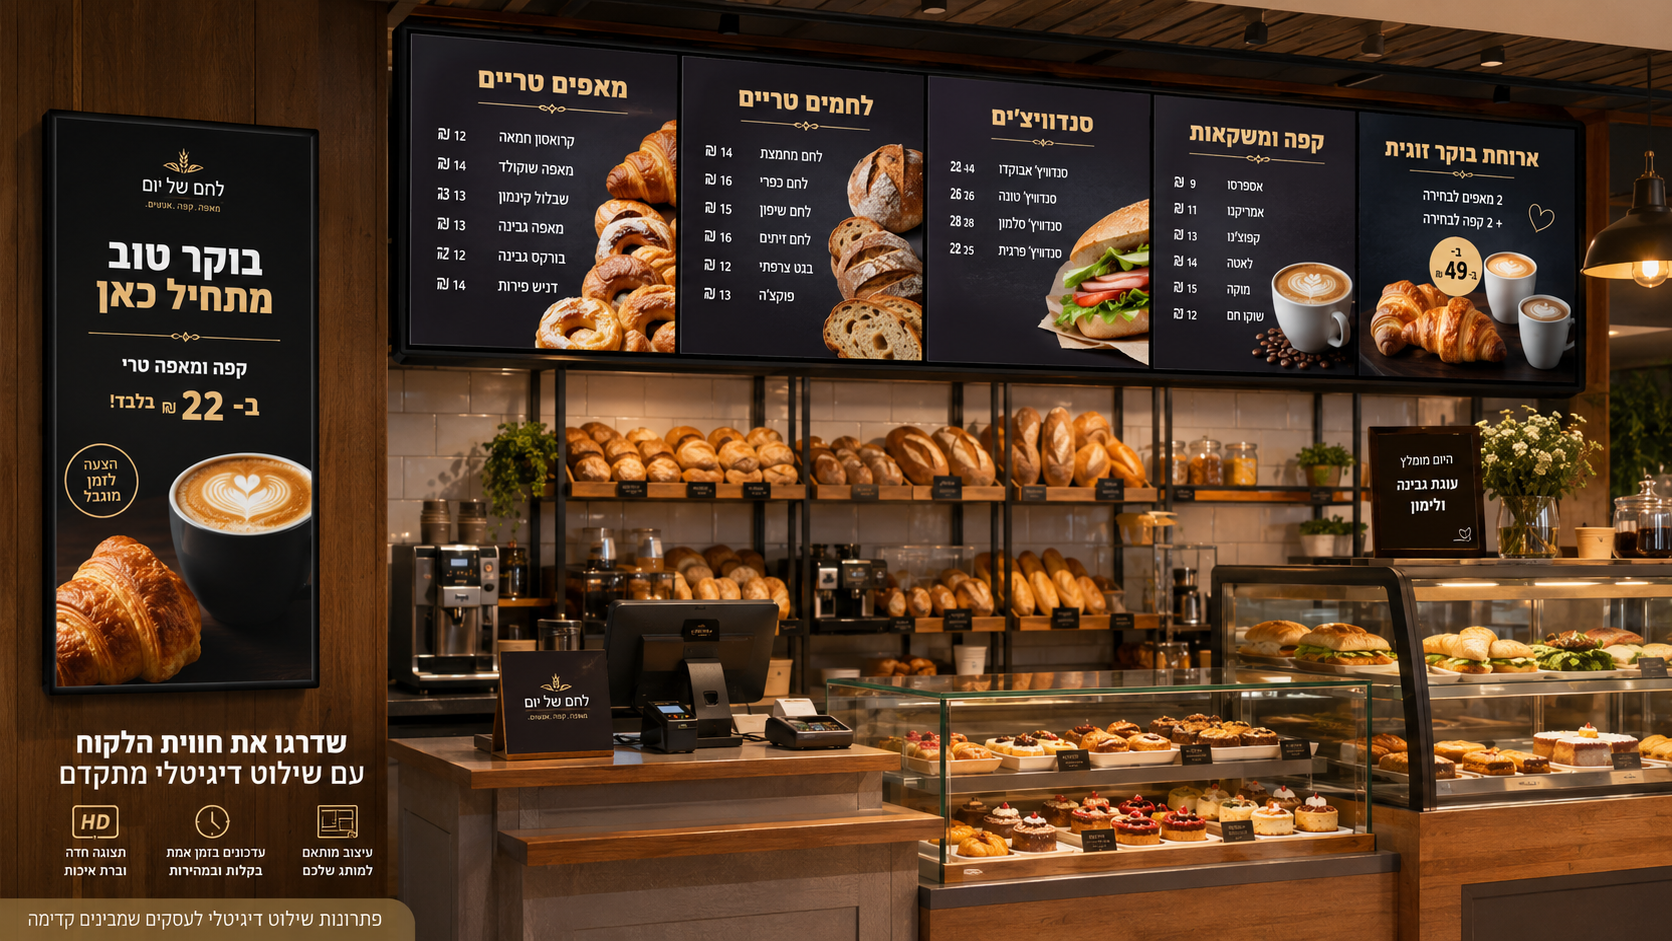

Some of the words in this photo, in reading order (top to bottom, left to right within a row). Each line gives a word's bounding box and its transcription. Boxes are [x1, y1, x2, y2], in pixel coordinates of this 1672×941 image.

[479, 70, 544, 92] טריים
[552, 76, 627, 98] מאפים
[739, 90, 798, 110] טריים
[806, 95, 873, 116] לחמים
[992, 109, 1093, 132] סנדוויצ'ים
[455, 131, 465, 141] 12
[500, 132, 531, 144] חמאה
[535, 135, 574, 149] קרואסון
[1190, 125, 1278, 147] ומשקאות
[1285, 132, 1324, 154] קפה
[721, 147, 732, 157] 14
[760, 149, 798, 160] מחמצת
[802, 150, 822, 162] לחם
[1385, 141, 1429, 159] זוגית
[1435, 145, 1477, 165] בוקר
[1482, 148, 1539, 167] ארוחת
[454, 160, 466, 170] 14
[499, 160, 538, 175] שוקולד
[542, 165, 573, 176] מאפה
[951, 161, 961, 172] 22
[999, 165, 1032, 177] אבוקדו
[1035, 165, 1068, 179] סנדוויץ'
[143, 179, 161, 192] יום
[167, 177, 188, 194] של
[721, 176, 732, 186] 16
[760, 177, 783, 187] כפרי
[787, 177, 808, 189] לחם
[1190, 179, 1196, 188] 9
[1228, 181, 1263, 191] אספרסו
[194, 181, 224, 196] לחם
[951, 188, 961, 199] 26
[454, 190, 465, 201] 13
[499, 192, 531, 206] קינמון
[535, 191, 568, 205] שבלול
[964, 191, 974, 200] 26
[999, 191, 1020, 202] טונה
[1024, 191, 1056, 205] סנדוויץ'
[1423, 190, 1459, 202] לבחירה
[1463, 193, 1493, 204] מאפים
[1497, 195, 1502, 205] 2
[720, 204, 732, 214] 15
[760, 205, 786, 217] שיפון
[790, 205, 811, 217] לחם
[1188, 205, 1196, 214] 11
[1228, 207, 1264, 218] אמריקנו
[454, 220, 465, 230] 13
[950, 215, 961, 227] 28
[964, 218, 974, 227] 28
[999, 217, 1025, 230] סלמון
[1028, 218, 1062, 232] סנדוויץ'
[1424, 213, 1459, 225] לבחירה
[1463, 217, 1483, 229] קפה
[1487, 218, 1492, 228] 2
[499, 221, 528, 232] גבינה
[532, 223, 563, 234] מאפה
[720, 232, 732, 242] 16
[760, 233, 786, 244] זיתים
[790, 233, 811, 245] לחם
[1188, 232, 1197, 241] 13
[1228, 231, 1260, 245] קפוצ'נו
[950, 242, 961, 254] 22
[999, 246, 1026, 256] פרגית
[1029, 246, 1062, 259] סנדוויץ'
[109, 242, 170, 271] טוב
[454, 250, 465, 260] 12
[499, 251, 528, 262] גבינה
[532, 253, 565, 265] בורקס
[182, 246, 262, 280] בוקר
[720, 261, 731, 271] 12
[759, 262, 790, 273] צרפתי
[1187, 258, 1197, 267] 14
[1227, 258, 1253, 269] לאטה
[794, 264, 813, 274] בגט
[1445, 261, 1467, 280] 49
[453, 280, 466, 290] 14
[498, 281, 528, 292] פירות
[532, 282, 558, 293] דניש
[1187, 284, 1197, 293] 15
[1227, 285, 1250, 296] מוקה
[97, 281, 156, 313] כאן
[167, 278, 272, 314] מתחיל
[720, 290, 731, 300] 13
[759, 289, 794, 304] פוקצ'ה
[1187, 310, 1197, 320] 12
[1227, 311, 1240, 320] חם
[1243, 312, 1264, 323] שוקו
[122, 359, 149, 372] טרי
[155, 360, 207, 374] ומאפה
[214, 362, 247, 379] קפה
[111, 393, 155, 409] בלבד!
[182, 390, 223, 421] 22
[162, 402, 176, 413] ₪
[84, 460, 117, 470] הצעה
[1400, 455, 1429, 468] מומלץ
[1433, 455, 1452, 464] היום
[87, 473, 116, 489] לזמן
[1397, 480, 1427, 490] גבינה
[1431, 479, 1458, 489] עוגת
[84, 490, 120, 502] מוגבל
[1411, 498, 1445, 514] ולימון
[525, 698, 540, 708] יום
[544, 695, 561, 707] של
[566, 694, 589, 706] לחם
